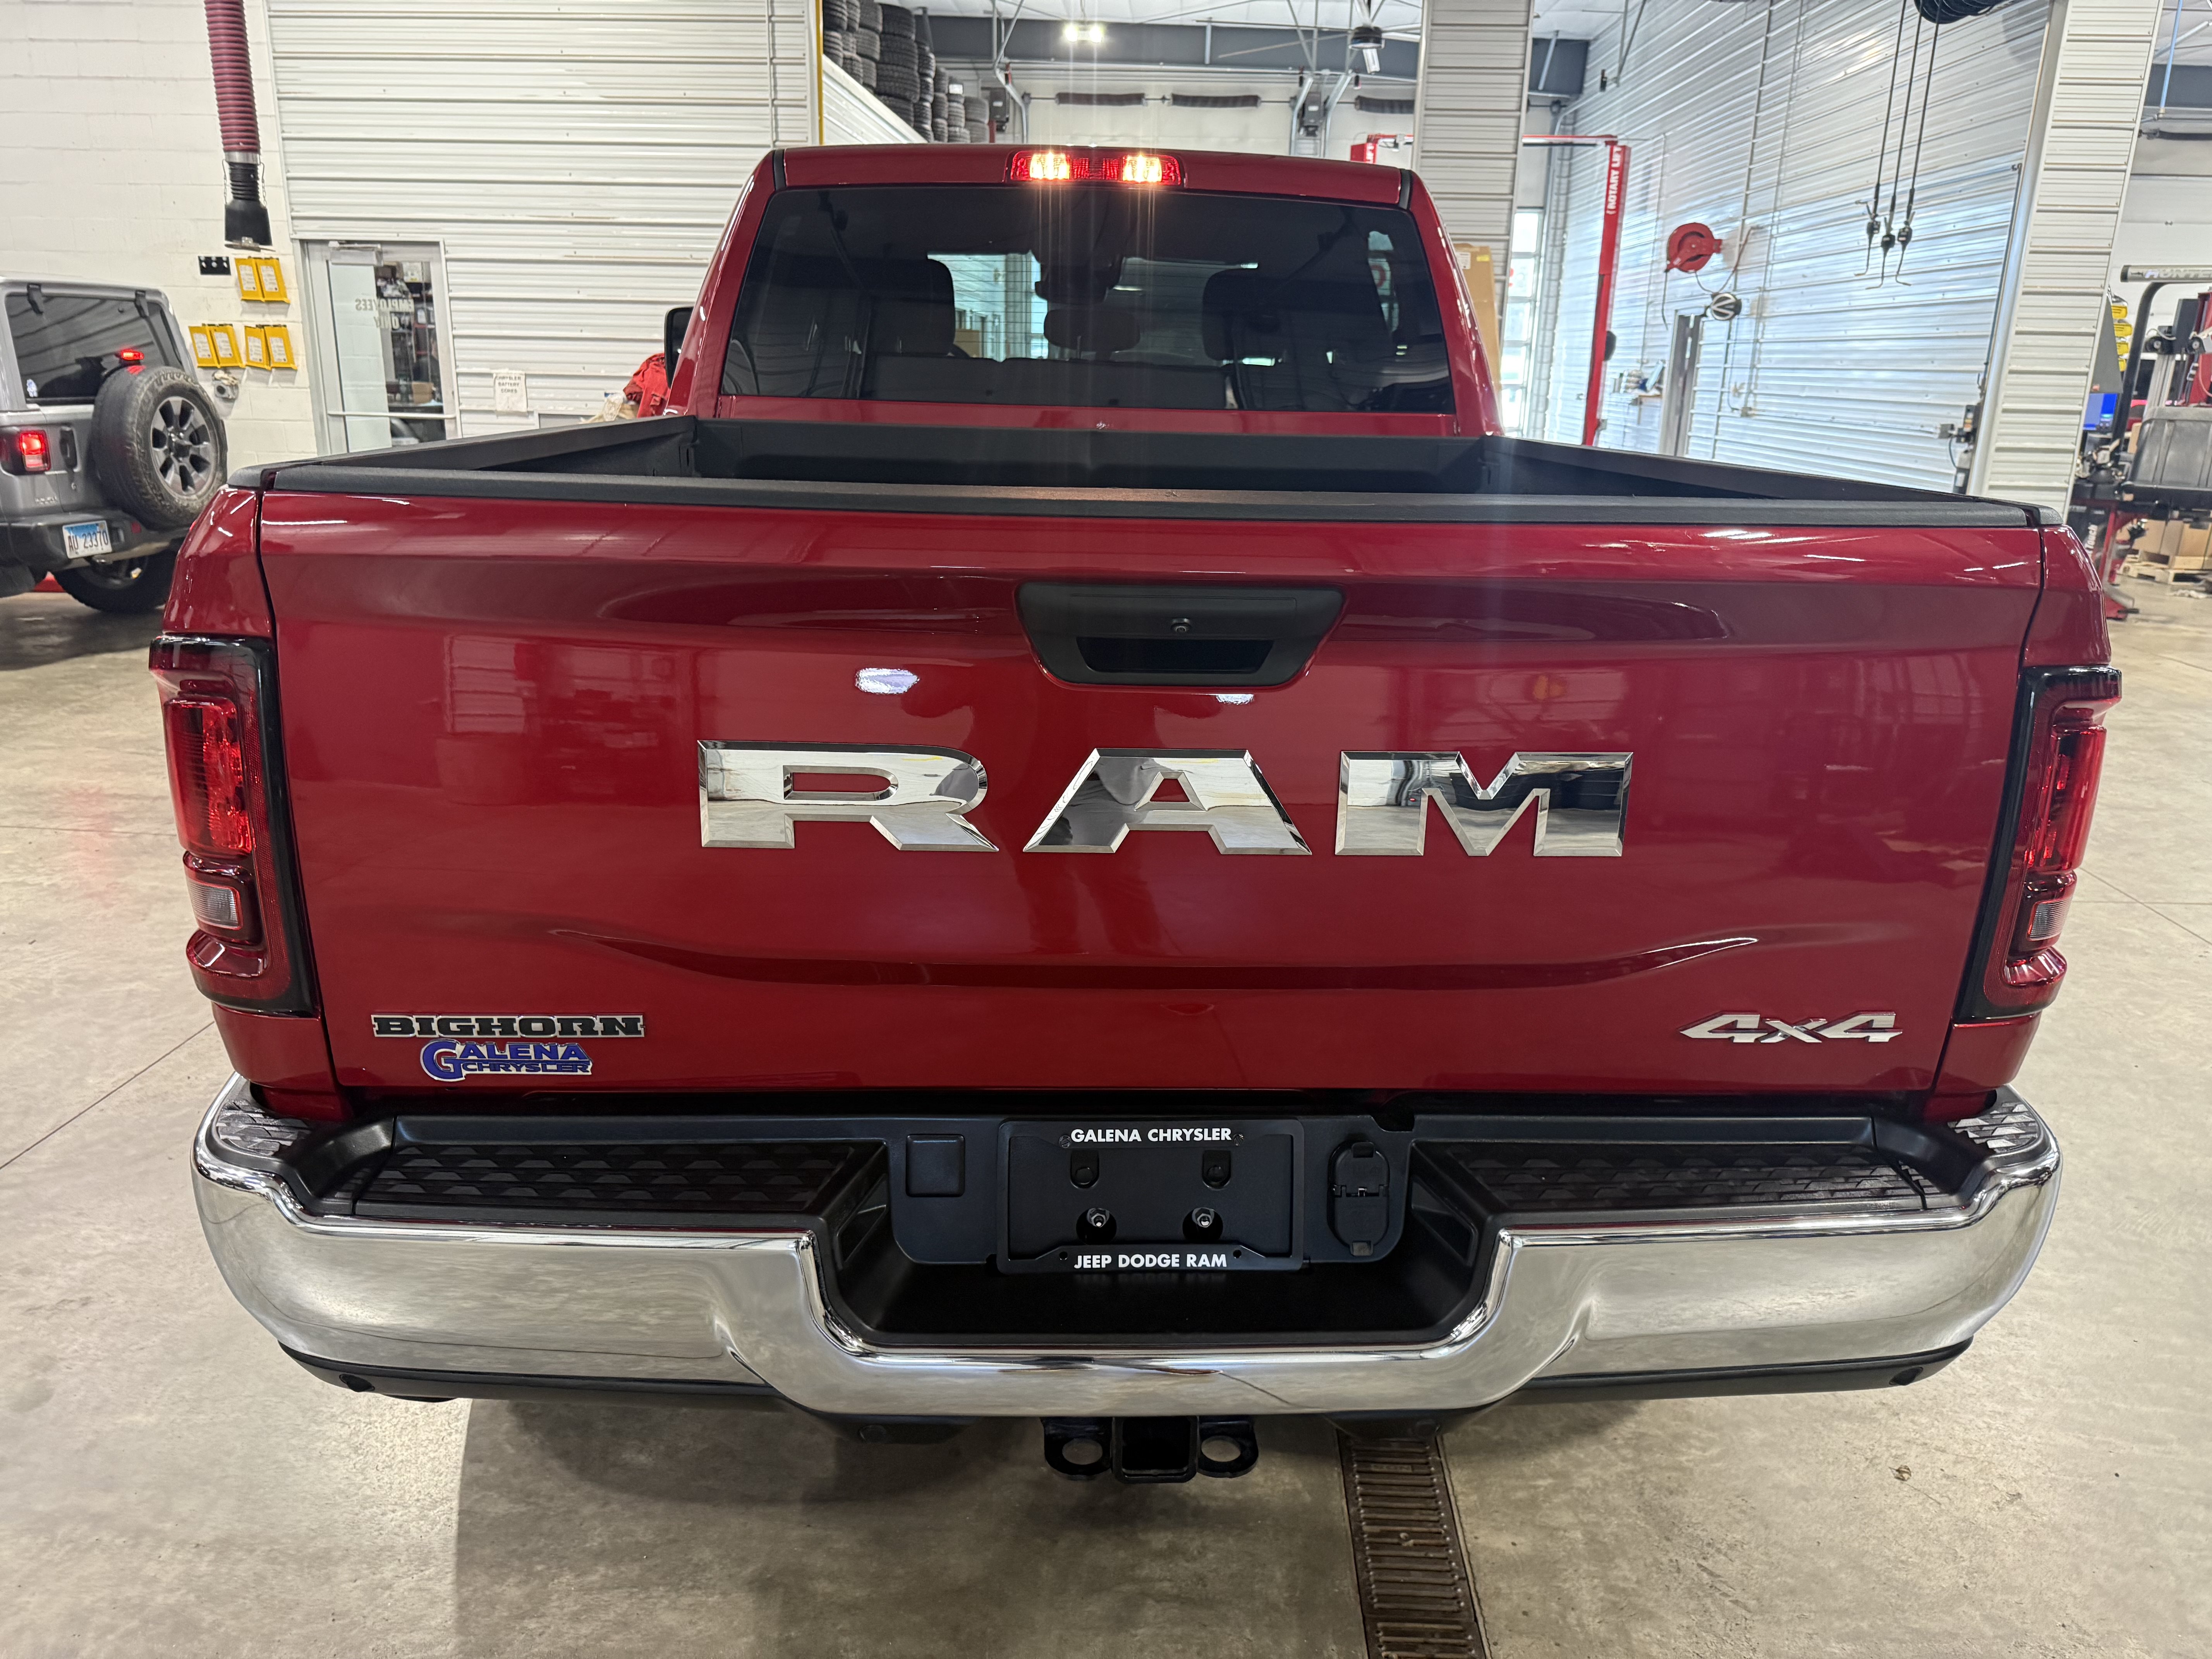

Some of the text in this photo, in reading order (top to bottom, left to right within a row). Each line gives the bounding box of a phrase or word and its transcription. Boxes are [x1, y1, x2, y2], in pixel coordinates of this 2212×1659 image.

[1607, 145, 1622, 210] ROTARY LIFT
[2145, 269, 2212, 279] HUNTE
[82, 530, 108, 549] 23370
[698, 739, 1633, 856] RAM
[371, 1015, 645, 1038] BIGHORN
[420, 1039, 593, 1081] GALENA
[464, 1062, 592, 1073] CHRYSLER
[1071, 1128, 1232, 1142] GALENA CHRYSLER
[1073, 1254, 1227, 1269] JEEP DODGE RAM
